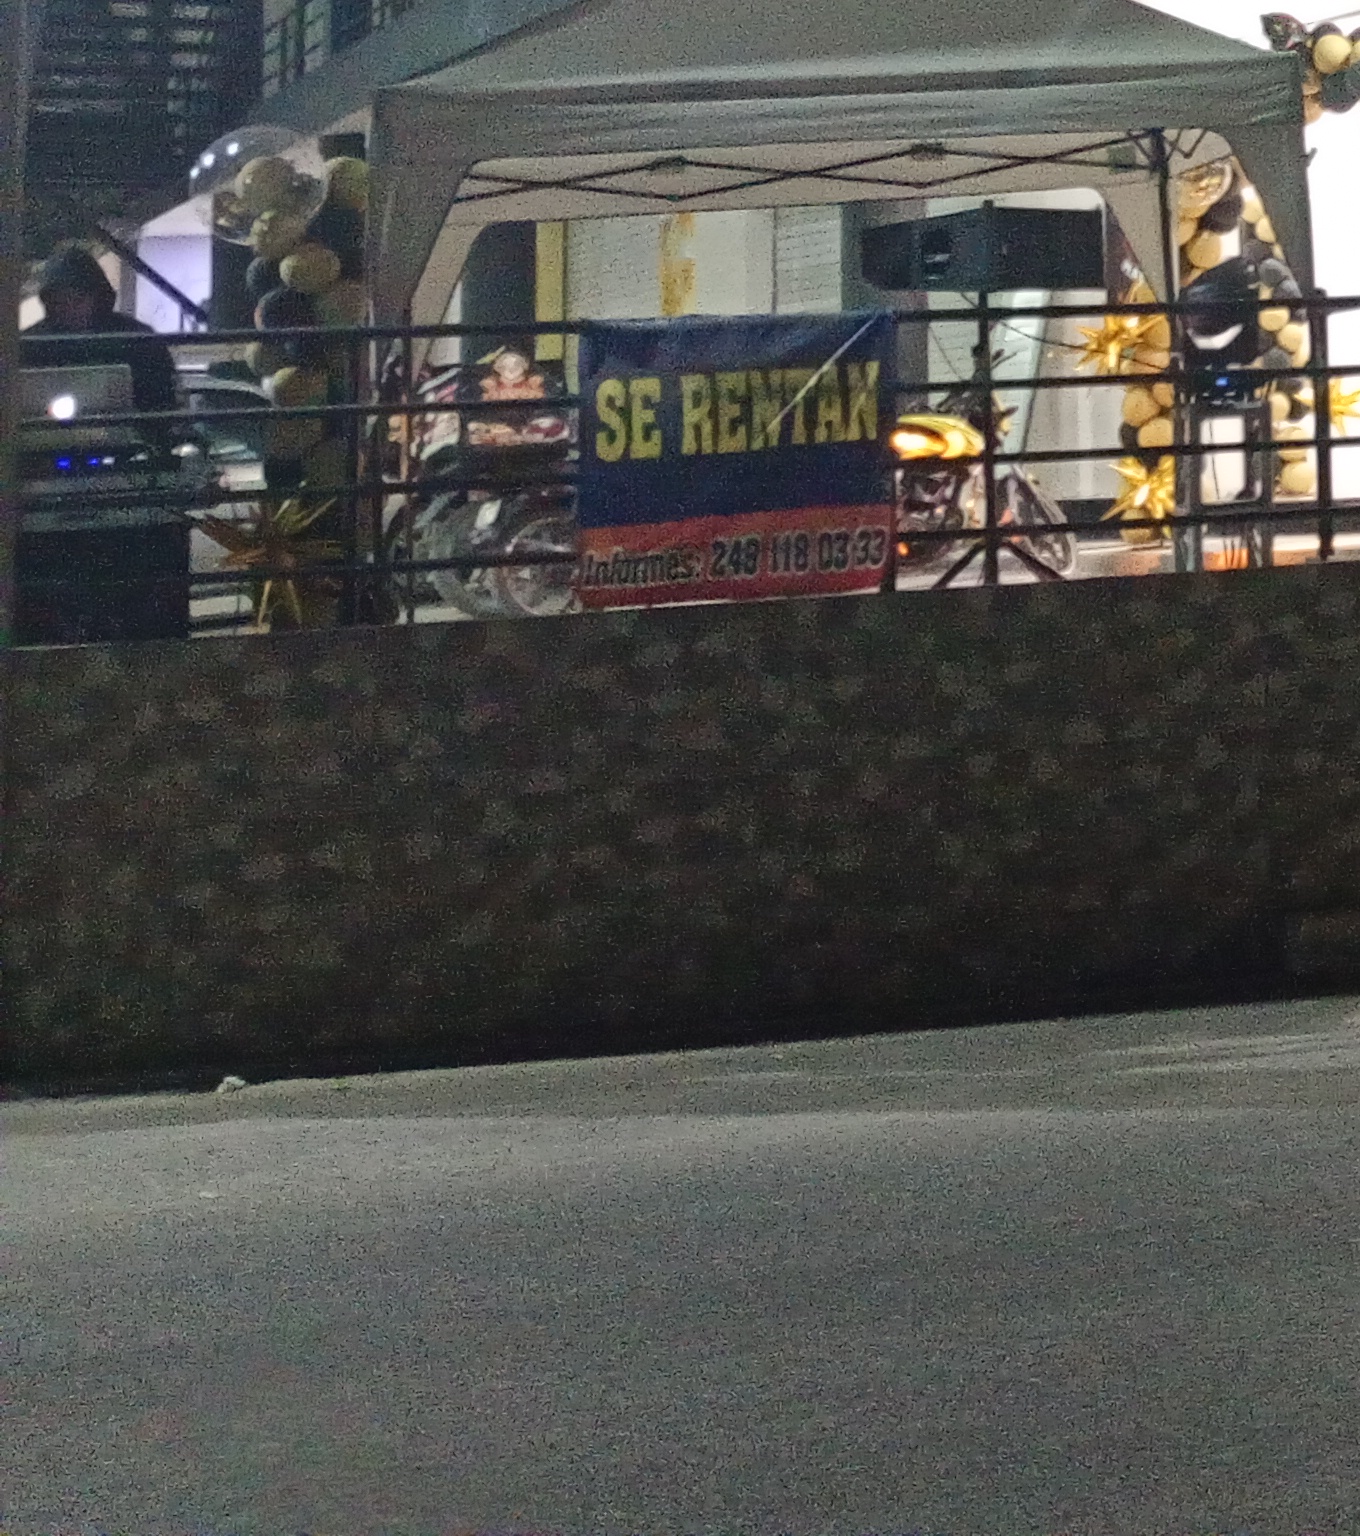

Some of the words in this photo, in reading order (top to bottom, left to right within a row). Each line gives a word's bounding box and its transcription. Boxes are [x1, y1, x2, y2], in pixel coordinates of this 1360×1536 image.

[596, 377, 662, 461] SE
[680, 361, 880, 455] RENTAN
[769, 531, 810, 574] 118
[817, 528, 850, 572] 03
[853, 525, 890, 569] 33
